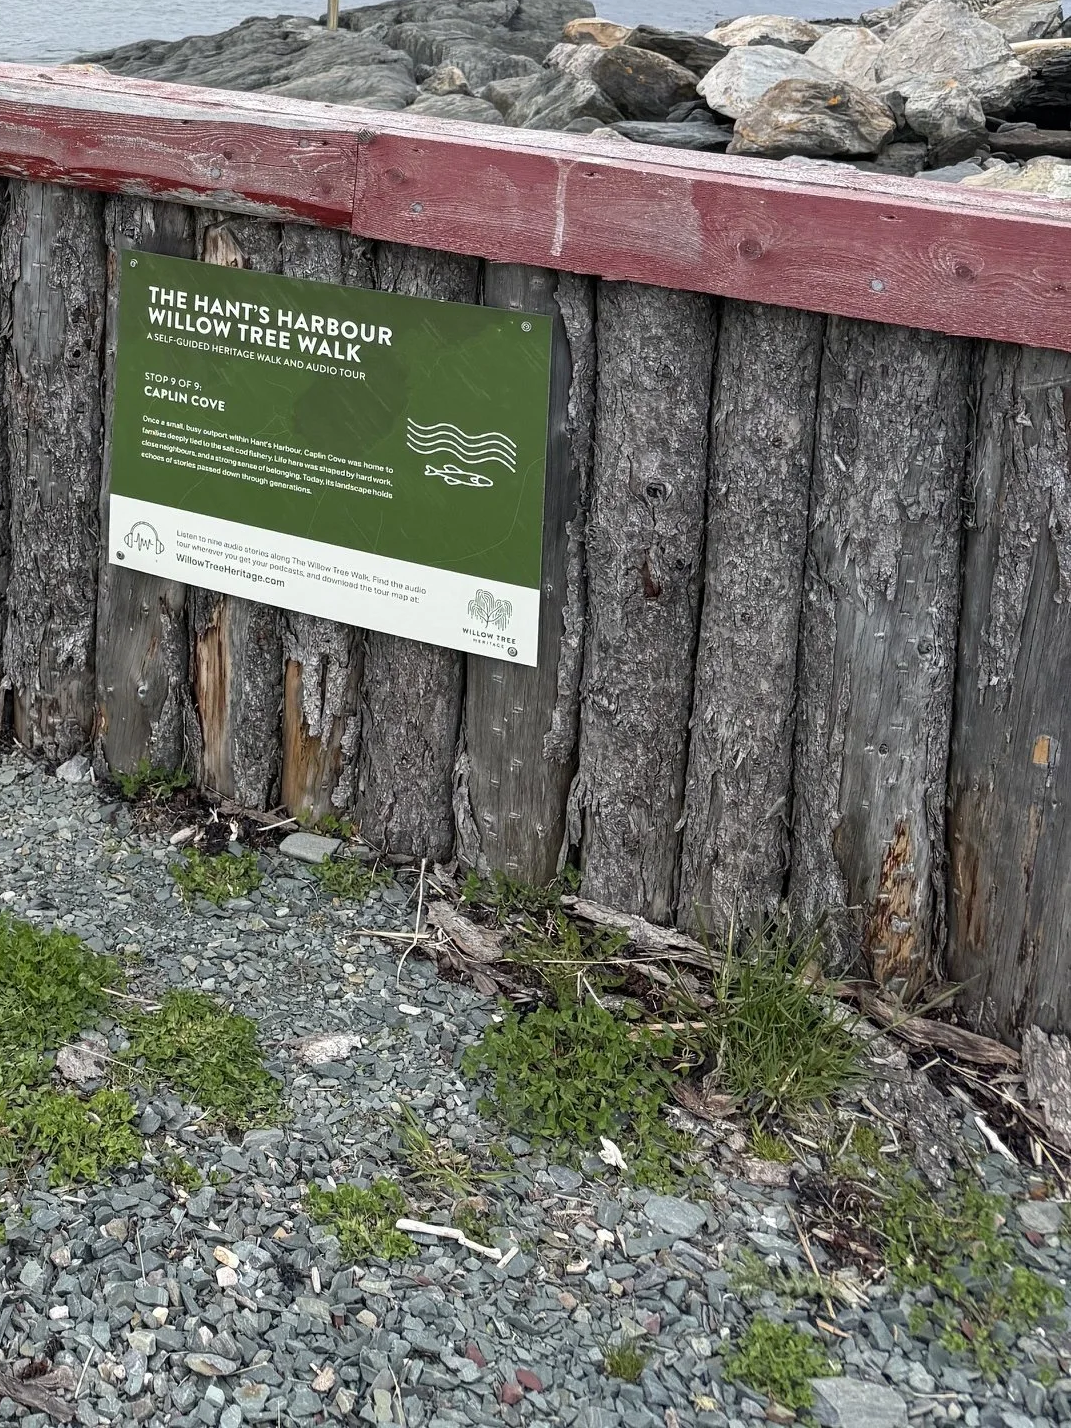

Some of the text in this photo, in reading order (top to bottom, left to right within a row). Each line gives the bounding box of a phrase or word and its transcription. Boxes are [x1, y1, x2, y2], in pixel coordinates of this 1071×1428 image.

[148, 286, 393, 346] THE HANT'S HARBOUR
[148, 306, 362, 363] WILLOW TREE WALK
[145, 372, 168, 386] STOP
[178, 378, 192, 389] OF
[194, 382, 202, 391] 9:
[154, 334, 210, 351] SELF-GUIDED
[212, 344, 255, 360] HERITAGE
[256, 353, 282, 365] WALK
[283, 358, 304, 369] AND
[306, 362, 337, 376] AUDIO
[339, 368, 366, 380] TOUR
[144, 386, 226, 411] CAPLIN COVE
[141, 451, 164, 462] echoes
[174, 459, 196, 469] stories
[197, 464, 221, 474] passed
[222, 469, 241, 479] down
[242, 473, 268, 485] through
[142, 427, 166, 438] families
[167, 432, 189, 444] deeply
[274, 456, 287, 464] Life
[288, 459, 303, 467] here
[319, 466, 345, 477] shaped
[346, 471, 355, 480] by
[356, 473, 372, 482] hard
[142, 440, 158, 449] close
[198, 451, 210, 460] and
[215, 454, 237, 466] strong
[237, 460, 257, 470] sense
[258, 463, 265, 472] of
[335, 481, 372, 495] landscape
[372, 488, 393, 499] holds
[143, 415, 159, 424] Once
[186, 425, 201, 434] busy
[203, 429, 228, 439] outport
[229, 435, 249, 443] within
[304, 450, 326, 460] Caplin
[328, 454, 346, 464] Cove
[348, 459, 362, 467] was
[363, 462, 384, 472] home
[176, 540, 191, 550] tour
[192, 544, 223, 557] wherever
[225, 552, 238, 561] you
[239, 555, 251, 564] get
[252, 559, 268, 568] your
[306, 572, 320, 581] and
[322, 575, 358, 590] download
[360, 584, 372, 593] the
[374, 587, 390, 597] tour
[391, 592, 408, 601] map
[176, 553, 285, 588] WillowTreeHeritage.com
[177, 530, 197, 540] Listen
[207, 538, 222, 546] nine
[224, 542, 243, 552] audio
[244, 547, 268, 558] stories
[270, 553, 290, 564] along
[292, 557, 306, 566] The
[308, 560, 331, 572] Willow
[333, 566, 349, 576] Tree
[373, 576, 389, 586] Find
[391, 580, 403, 590] the
[405, 584, 426, 594] audio
[462, 628, 516, 644] WILLOW TREE
